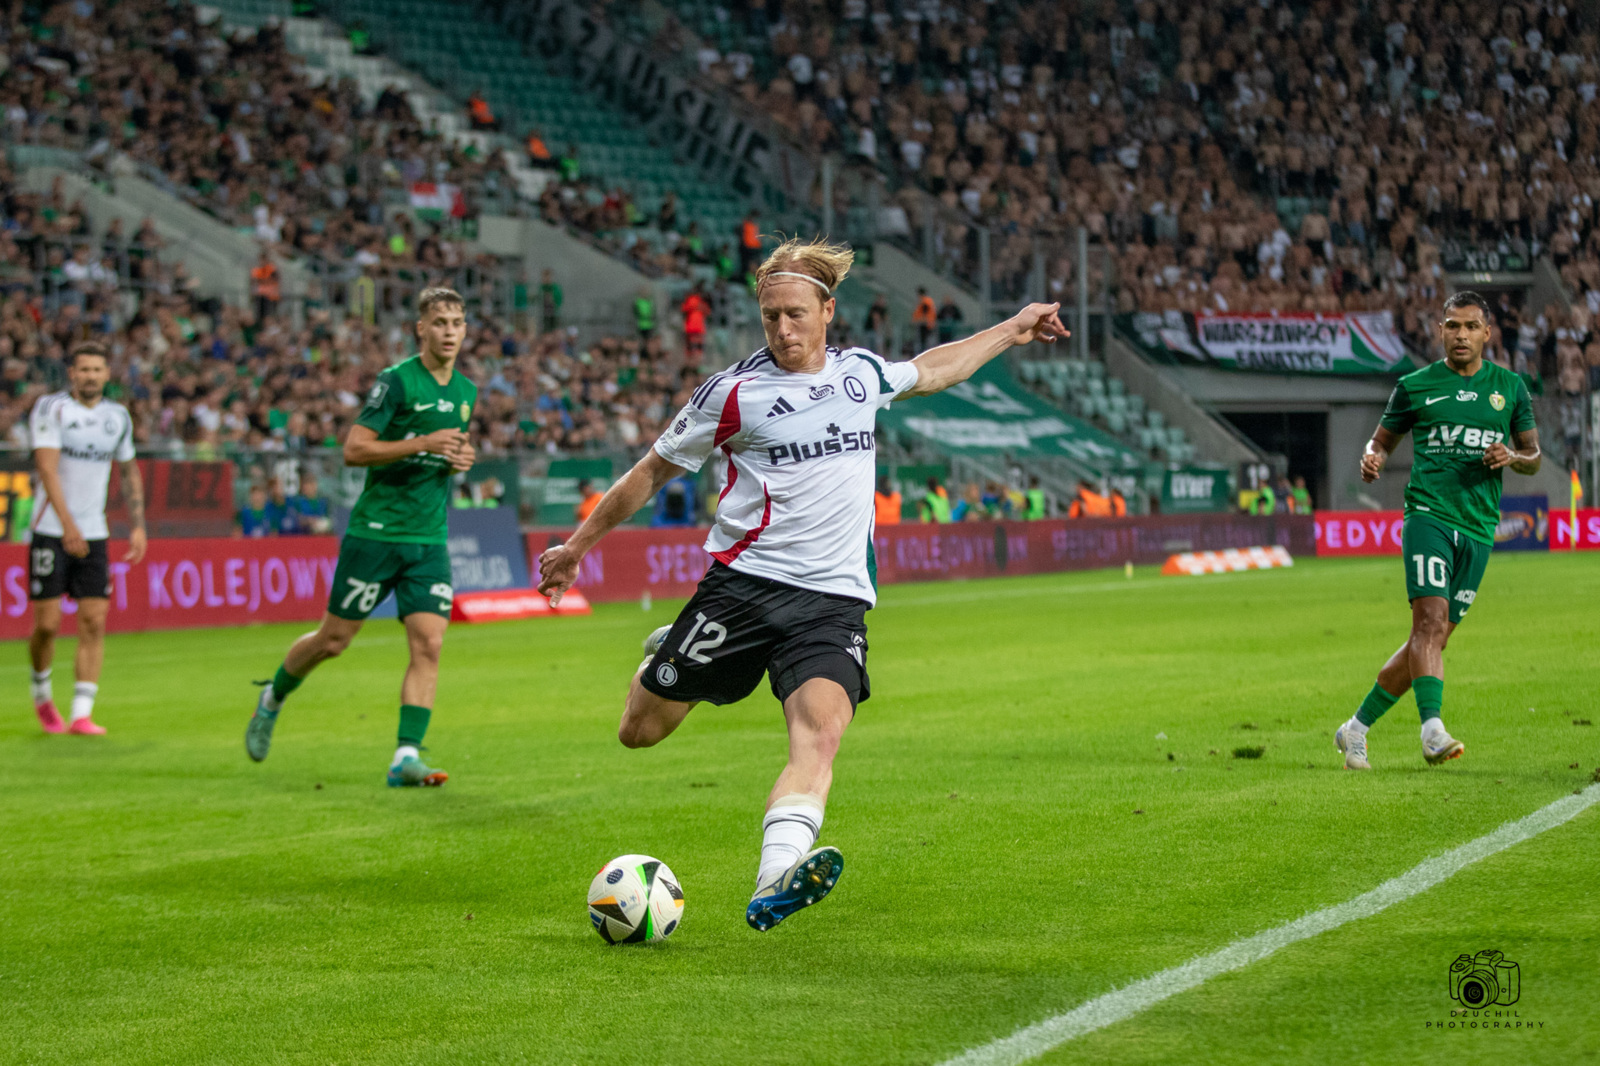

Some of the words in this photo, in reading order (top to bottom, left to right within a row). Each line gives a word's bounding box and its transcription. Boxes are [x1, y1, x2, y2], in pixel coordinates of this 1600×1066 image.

[1413, 554, 1447, 588] 10
[341, 577, 380, 612] 78
[677, 612, 726, 664] 12
